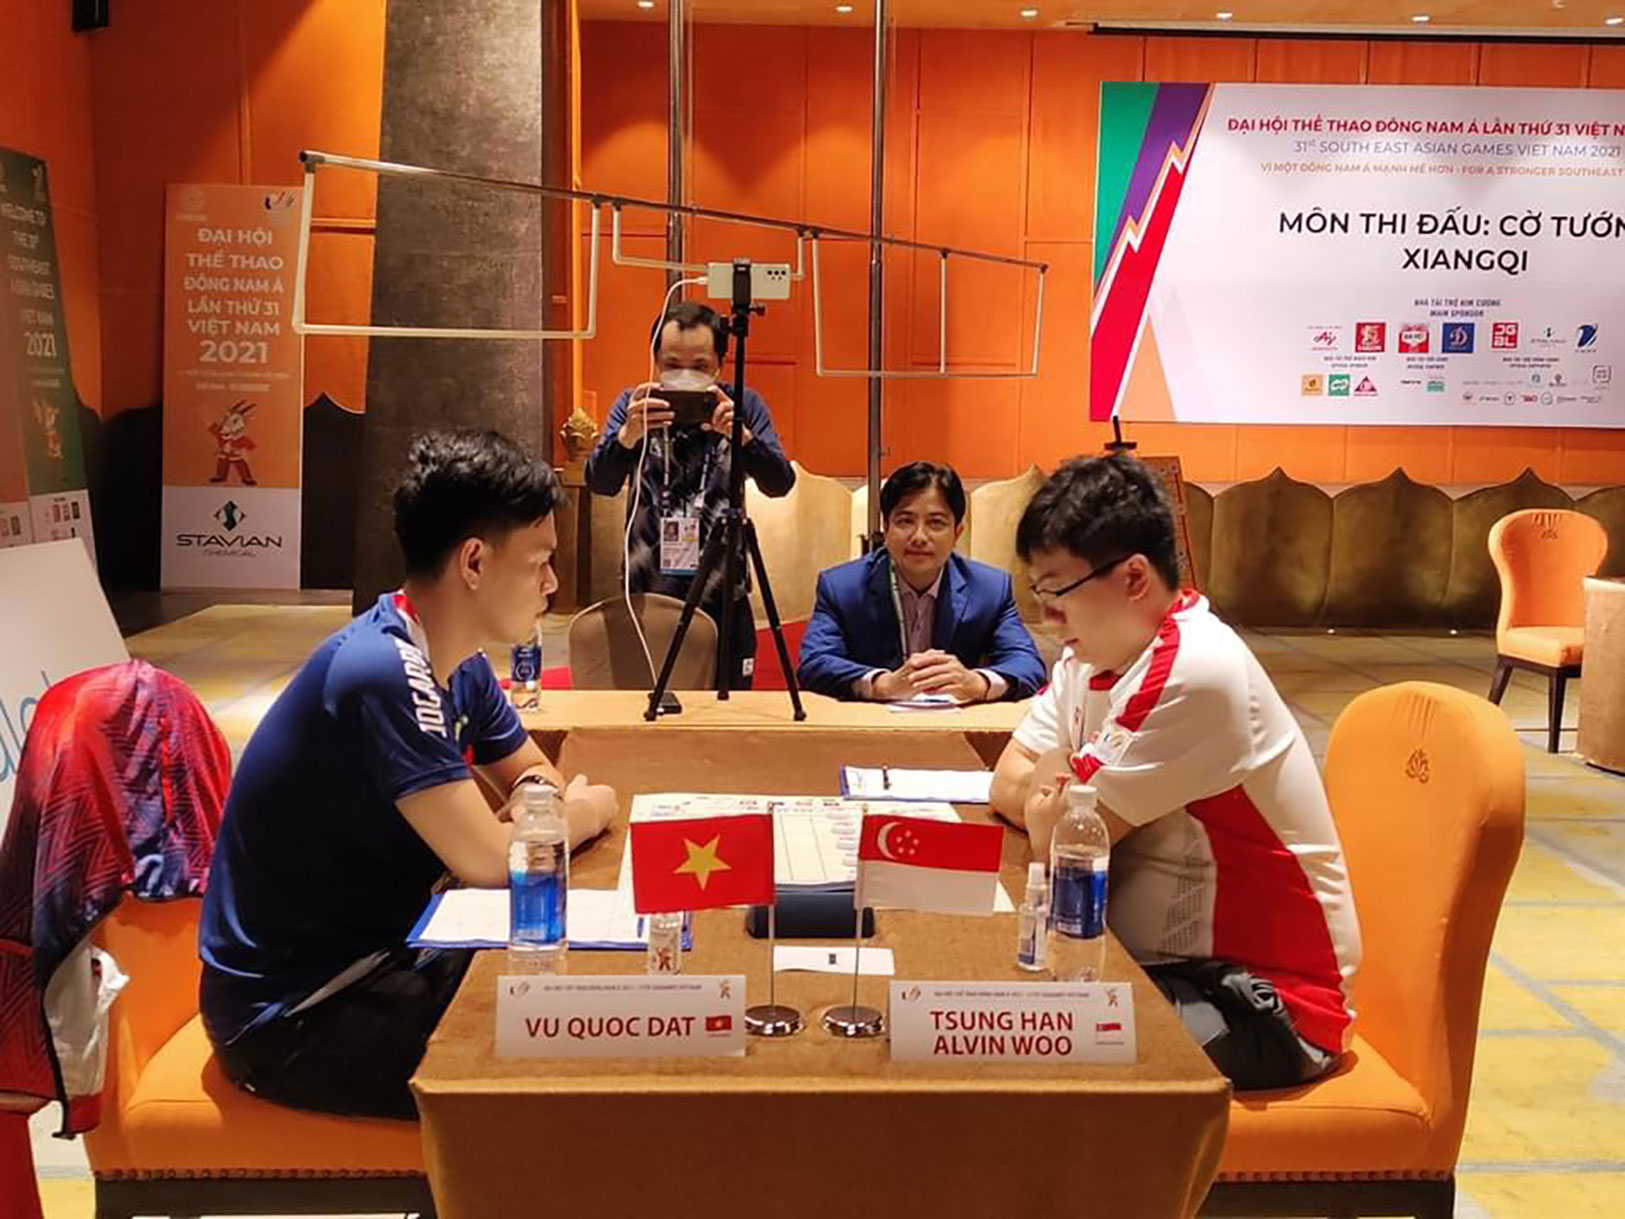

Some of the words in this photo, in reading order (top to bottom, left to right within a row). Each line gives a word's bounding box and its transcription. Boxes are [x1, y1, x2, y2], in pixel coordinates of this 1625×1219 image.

[1228, 118, 1255, 134] ĐẠI
[1260, 116, 1288, 135] HỘI
[1292, 113, 1322, 132] THỂ
[1327, 118, 1372, 132] THAO
[1376, 117, 1422, 133] ĐÔNG
[1426, 121, 1463, 134] NAM
[1468, 117, 1478, 134] Á
[1484, 116, 1515, 134] LẦN
[1518, 120, 1553, 136] THỨ
[1556, 123, 1570, 136] 31
[1574, 121, 1610, 140] VIỆT
[1320, 141, 1370, 153] SOUTH
[1374, 142, 1409, 154] EAST
[1414, 142, 1456, 154] ASIAN
[1462, 143, 1513, 156] GAMES
[1517, 144, 1548, 156] VIET
[1552, 145, 1587, 156] NAM
[1590, 146, 1621, 157] 2021
[1335, 163, 1360, 172] NAM
[1462, 165, 1484, 174] FOR
[1487, 165, 1497, 174] A
[1499, 166, 1556, 176] STRONGER
[1558, 166, 1623, 176] SOUTHEAST
[1279, 206, 1349, 234] MÔN
[1360, 213, 1406, 234] THI
[1417, 206, 1490, 236] ĐẤU:
[1500, 210, 1543, 236] CỜ
[198, 229, 232, 246] ĐẠI
[238, 228, 272, 246] HỘI
[188, 250, 224, 268] THỂ
[230, 254, 284, 270] THAO
[1402, 248, 1528, 275] XIANGQI
[184, 274, 230, 290] ĐÔNG
[234, 278, 268, 292] NAM
[272, 275, 284, 293] Á
[226, 298, 264, 316] THỨ
[264, 302, 280, 316] 31
[188, 318, 230, 337] VIỆT
[236, 322, 280, 336] NAM
[200, 340, 270, 364] 2021
[176, 534, 282, 548] STAVIAN
[525, 1016, 560, 1037] VU
[567, 1016, 640, 1039] QUOC
[648, 1016, 696, 1036] DAT
[930, 1010, 1013, 1031] TSUNG
[1021, 1012, 1074, 1031] HAN
[934, 1036, 1004, 1055] ALVIN
[1011, 1035, 1072, 1056] WOO
